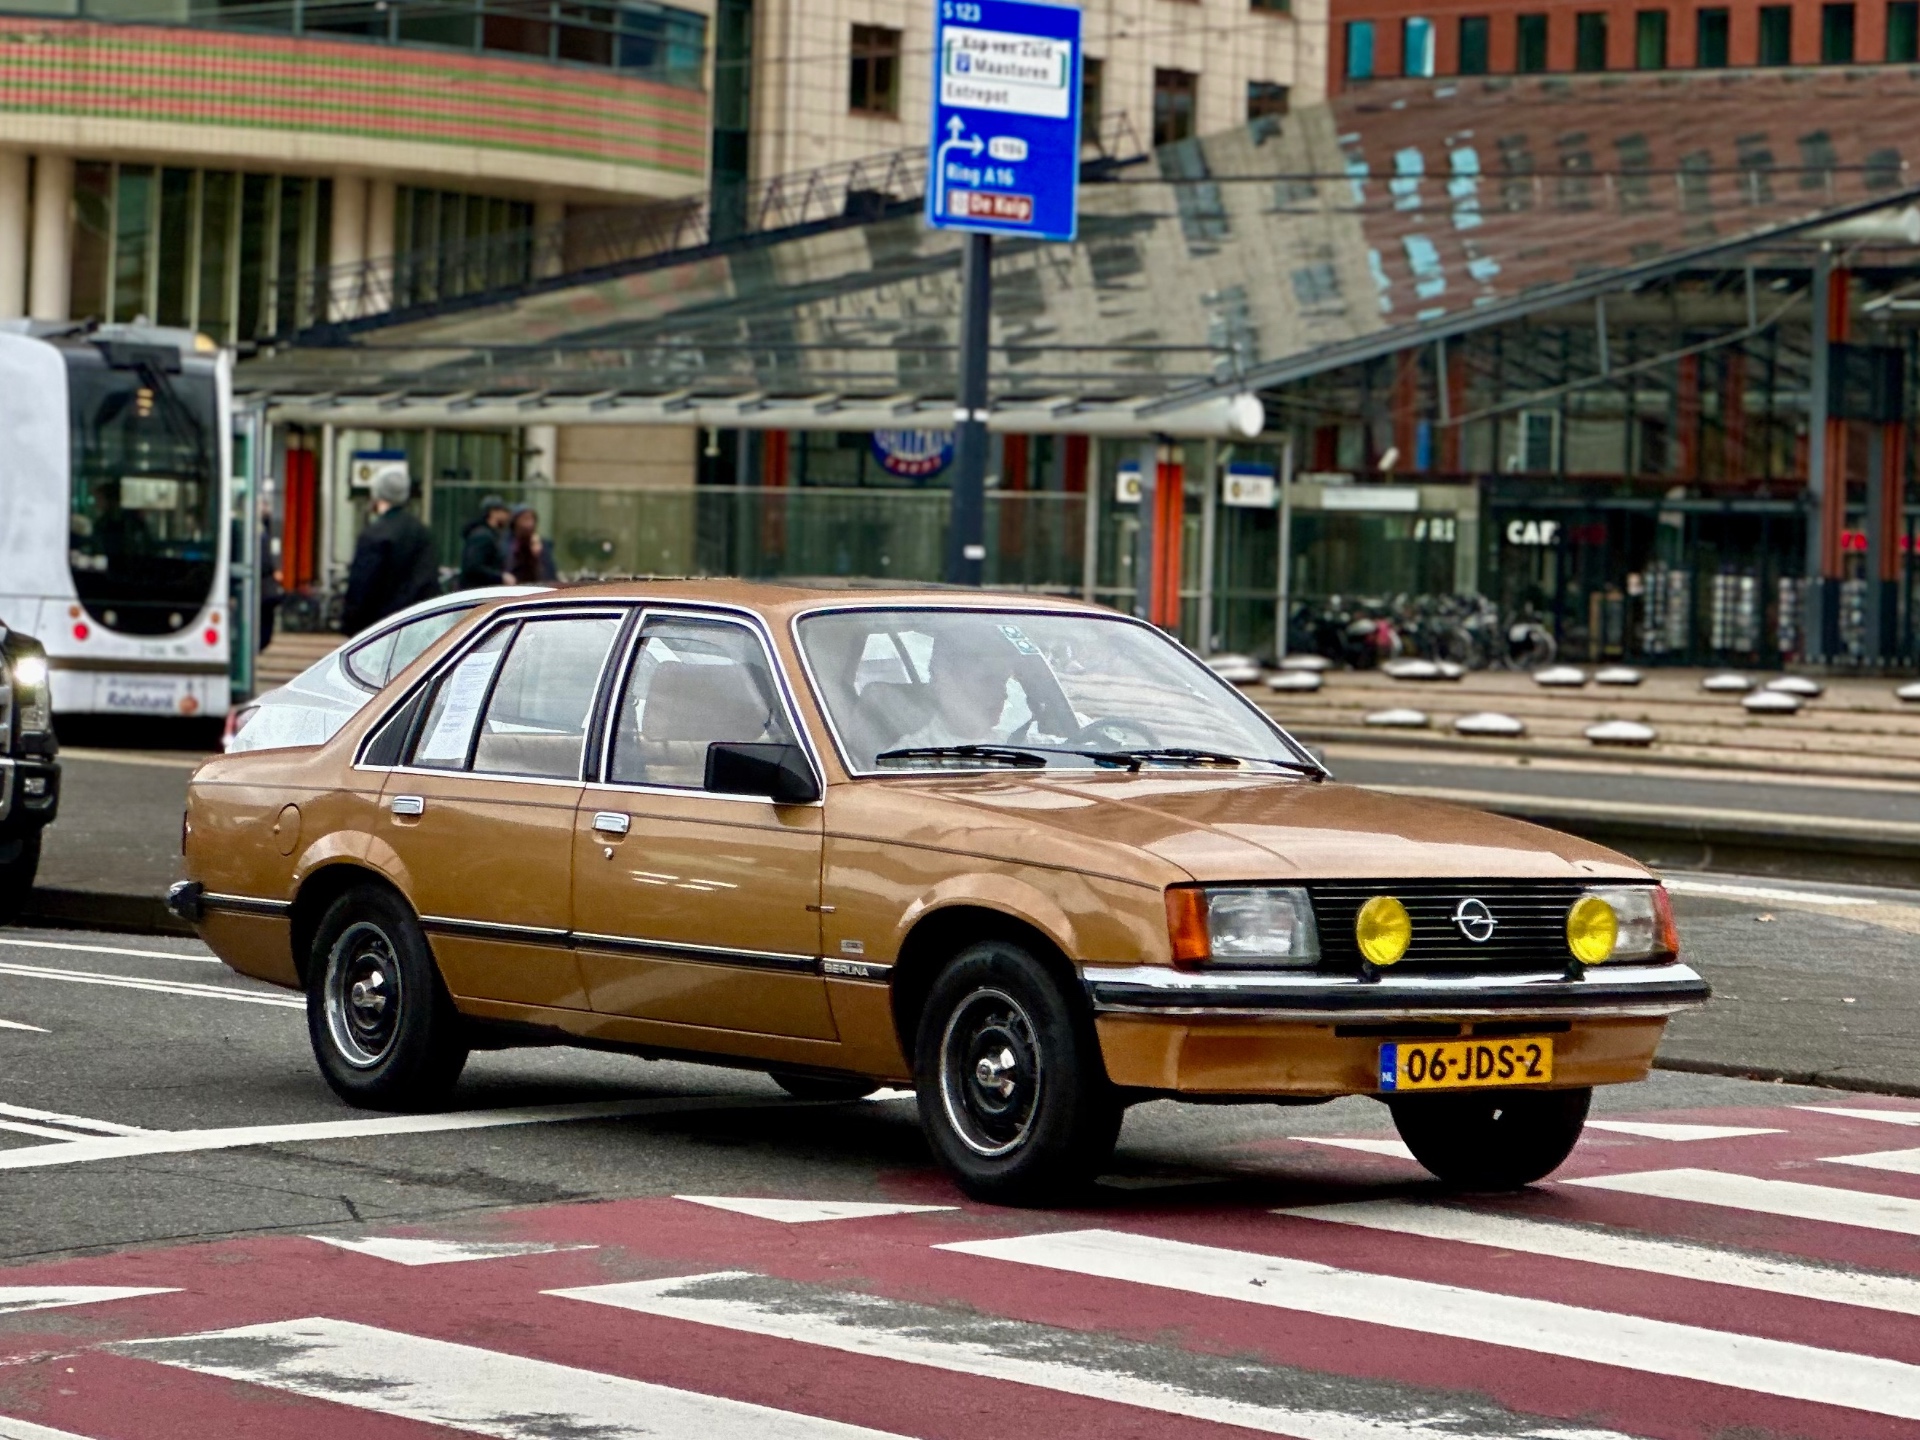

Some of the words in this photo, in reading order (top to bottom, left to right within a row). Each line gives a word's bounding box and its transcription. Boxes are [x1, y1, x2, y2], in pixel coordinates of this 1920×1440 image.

[943, 1, 954, 19] S
[955, 3, 981, 22] 123
[962, 34, 989, 53] Kop
[1021, 40, 1052, 59] Zuid
[975, 58, 1048, 80] Maastoren
[946, 82, 1008, 104] Entrepot
[946, 163, 980, 187] Ring
[971, 195, 992, 214] De
[994, 197, 1029, 218] Kuip
[824, 963, 869, 976] BERLINA
[1407, 1043, 1543, 1083] 06-JDS-2
[1381, 1071, 1395, 1083] NL
